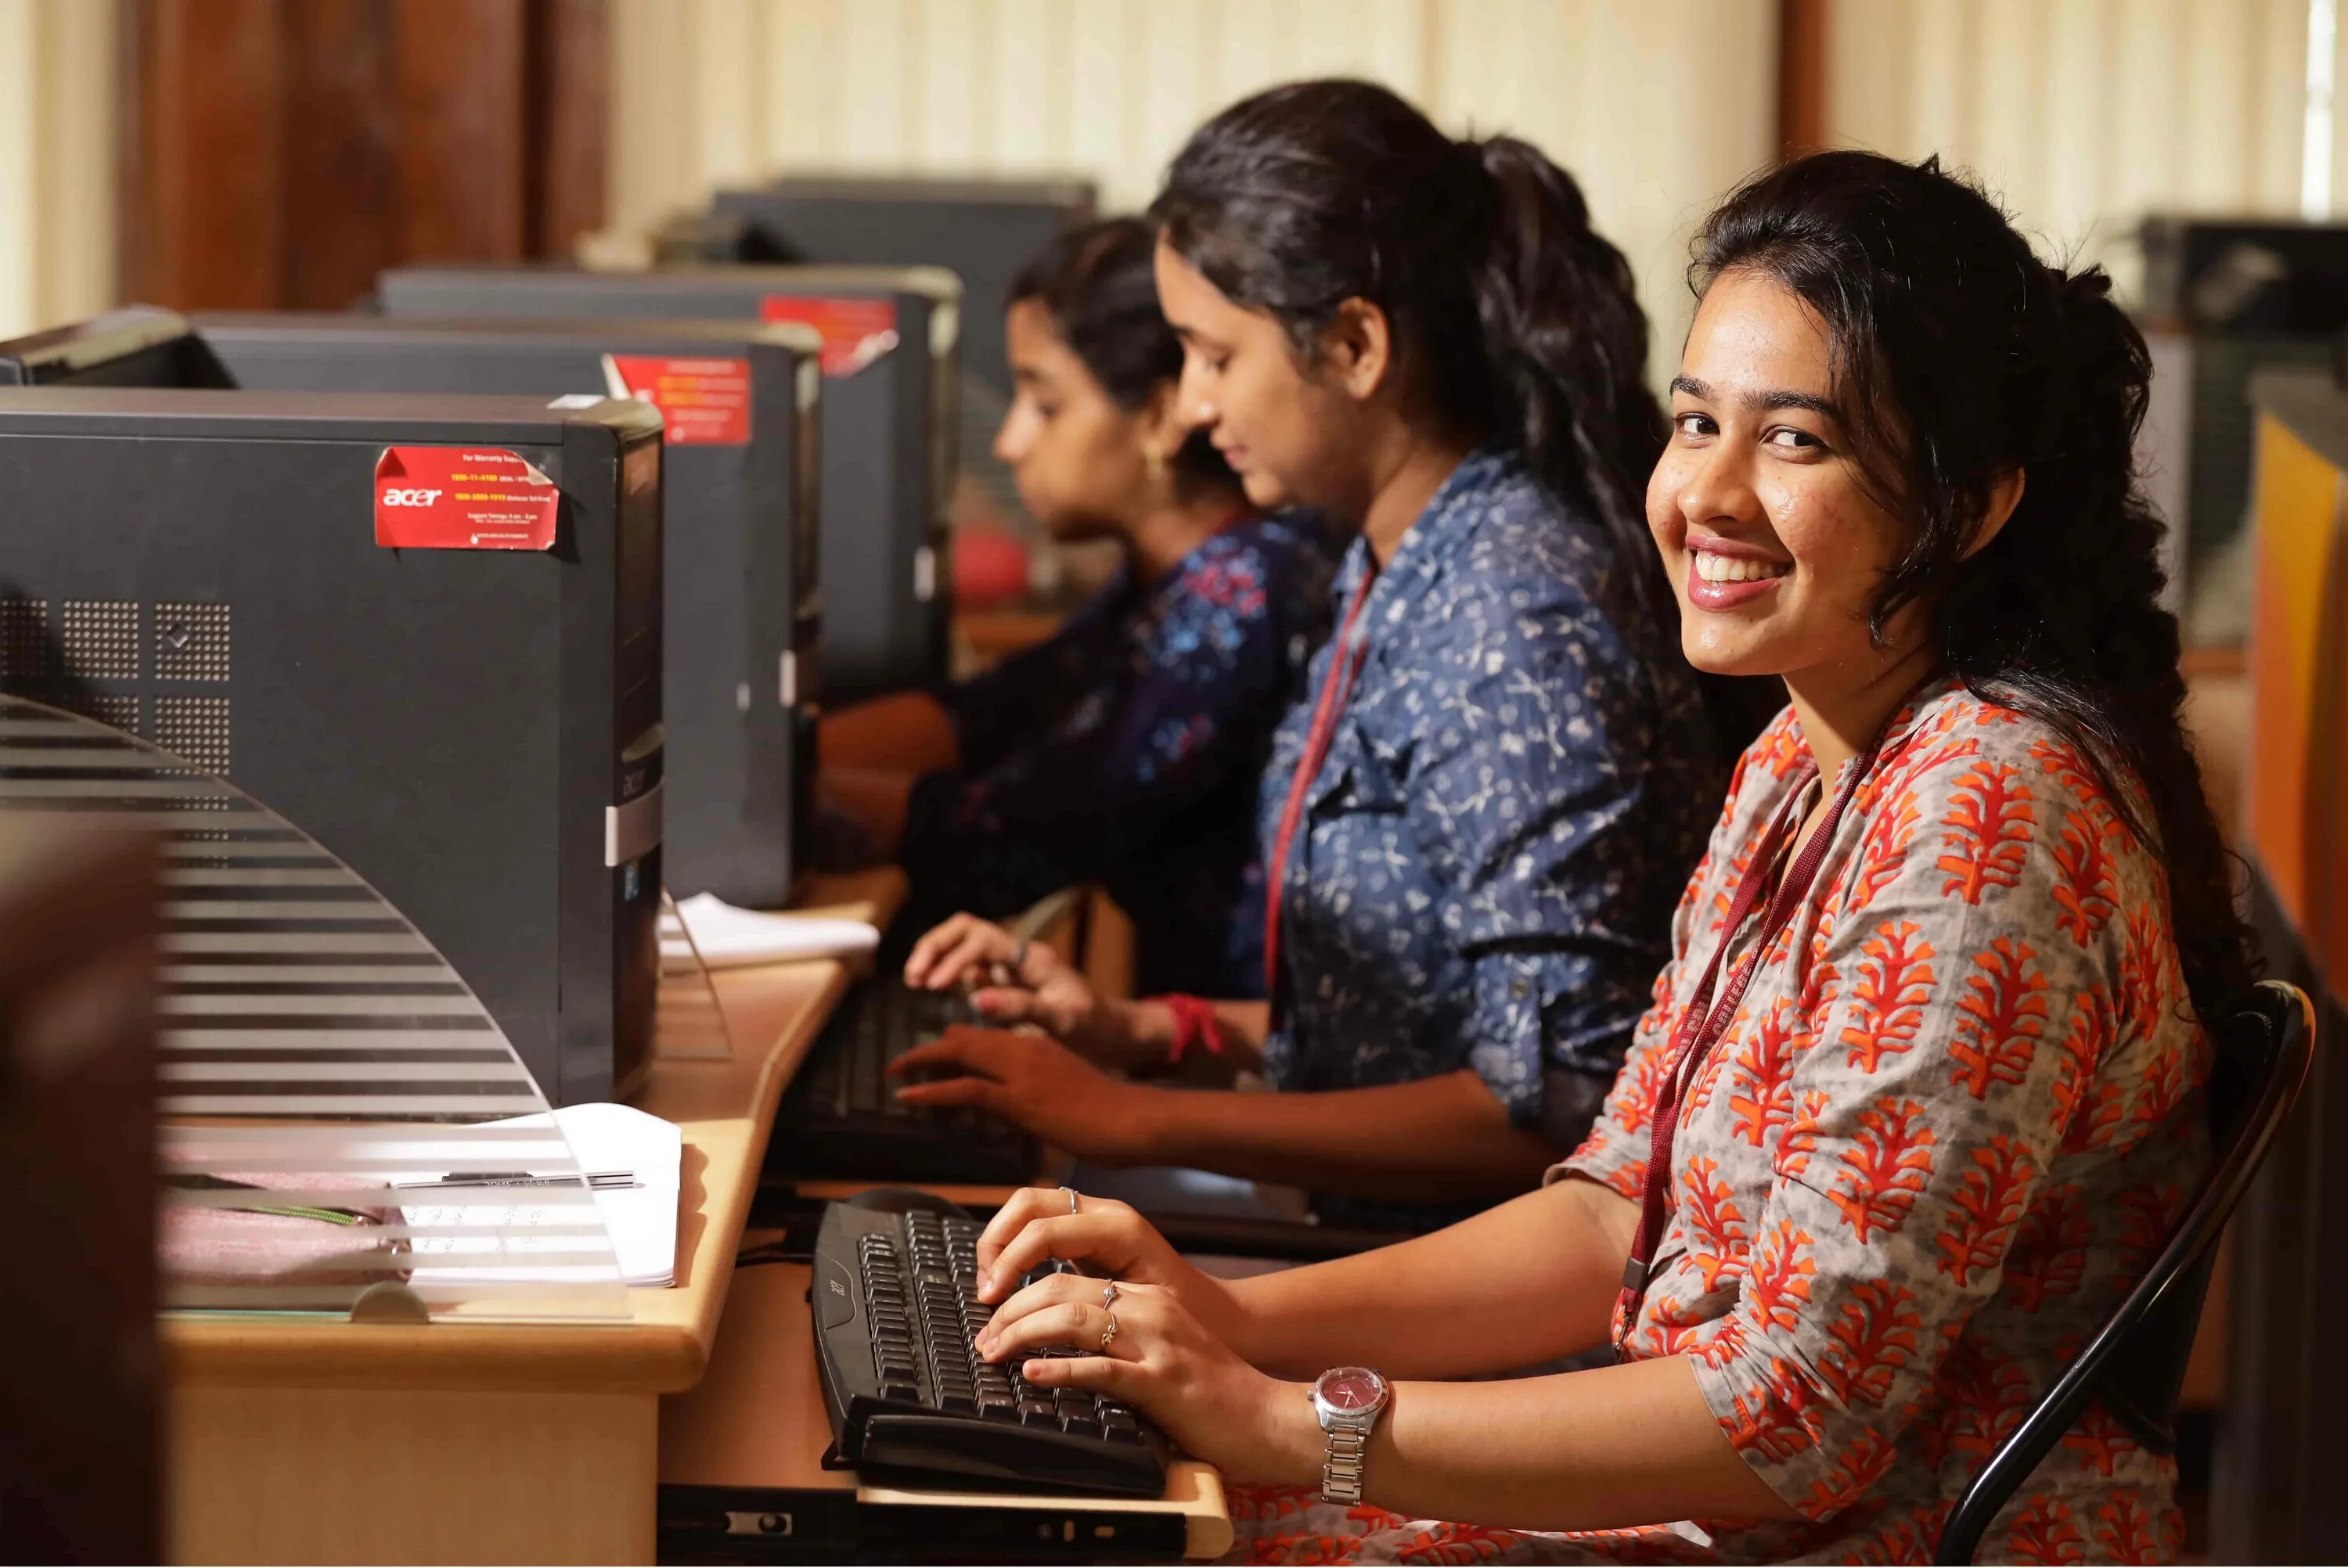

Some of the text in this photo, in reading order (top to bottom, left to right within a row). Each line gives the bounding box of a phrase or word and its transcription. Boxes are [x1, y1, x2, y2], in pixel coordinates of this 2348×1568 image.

[474, 454, 503, 463] Warranty
[383, 488, 442, 507] acer
[830, 1279, 845, 1296] acer
